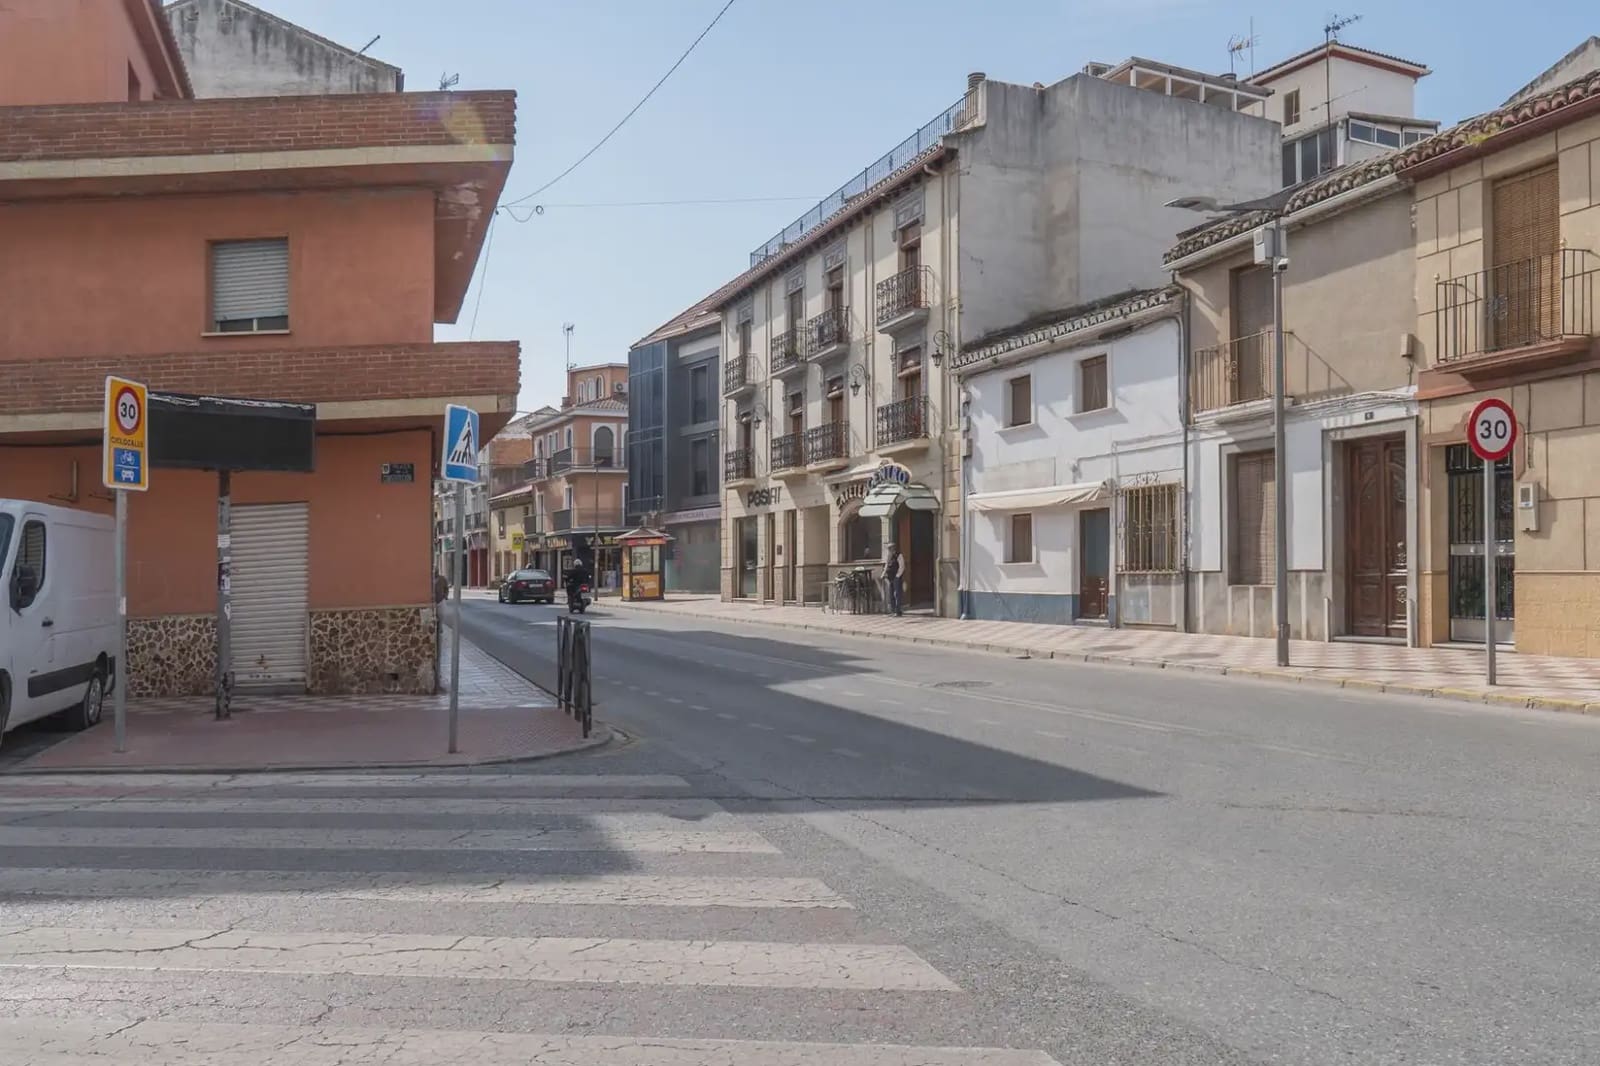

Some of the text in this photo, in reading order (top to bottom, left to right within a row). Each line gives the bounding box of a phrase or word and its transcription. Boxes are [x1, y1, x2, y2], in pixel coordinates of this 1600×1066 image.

[120, 401, 136, 419] 30
[1480, 419, 1507, 439] 30
[867, 464, 909, 489] CENTRO
